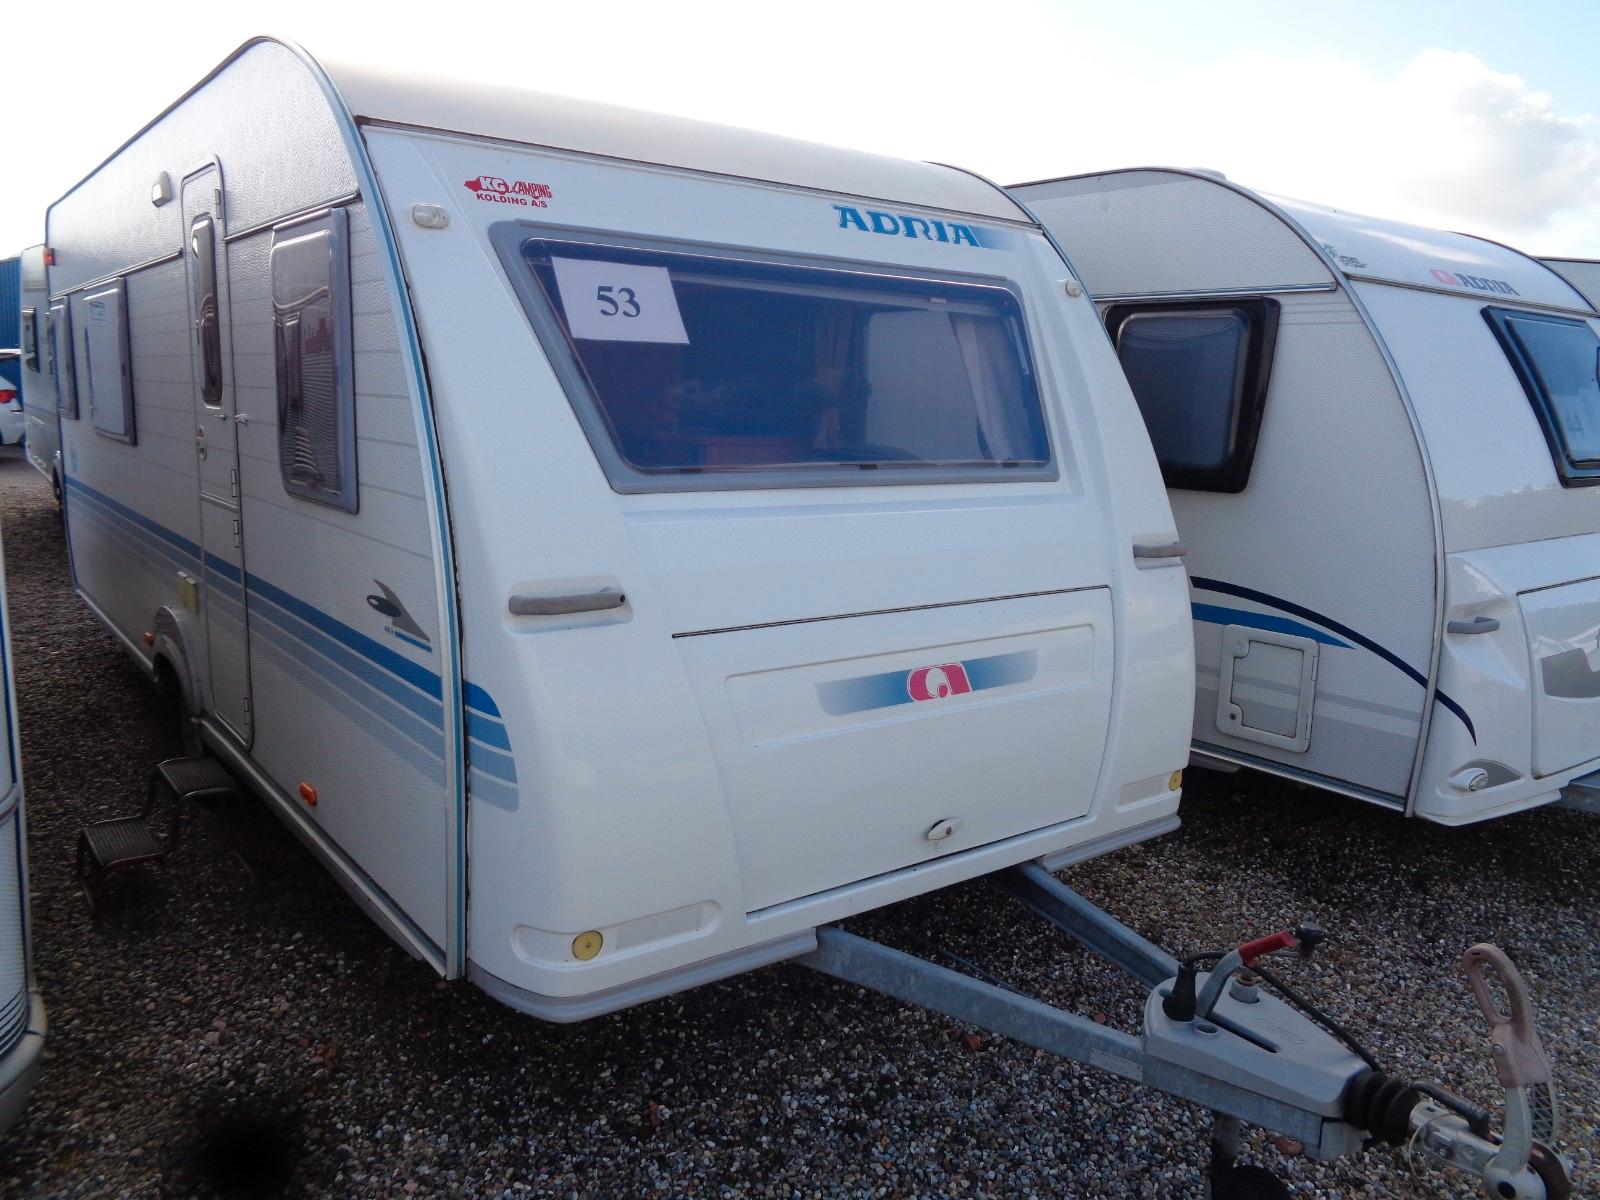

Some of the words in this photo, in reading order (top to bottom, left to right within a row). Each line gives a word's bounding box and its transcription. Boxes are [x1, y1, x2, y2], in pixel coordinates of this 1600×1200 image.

[476, 193, 527, 206] KOLDING
[531, 200, 547, 208] A/S
[832, 203, 981, 248] ADRIA
[1455, 273, 1520, 297] ADRIA
[596, 285, 641, 318] 53
